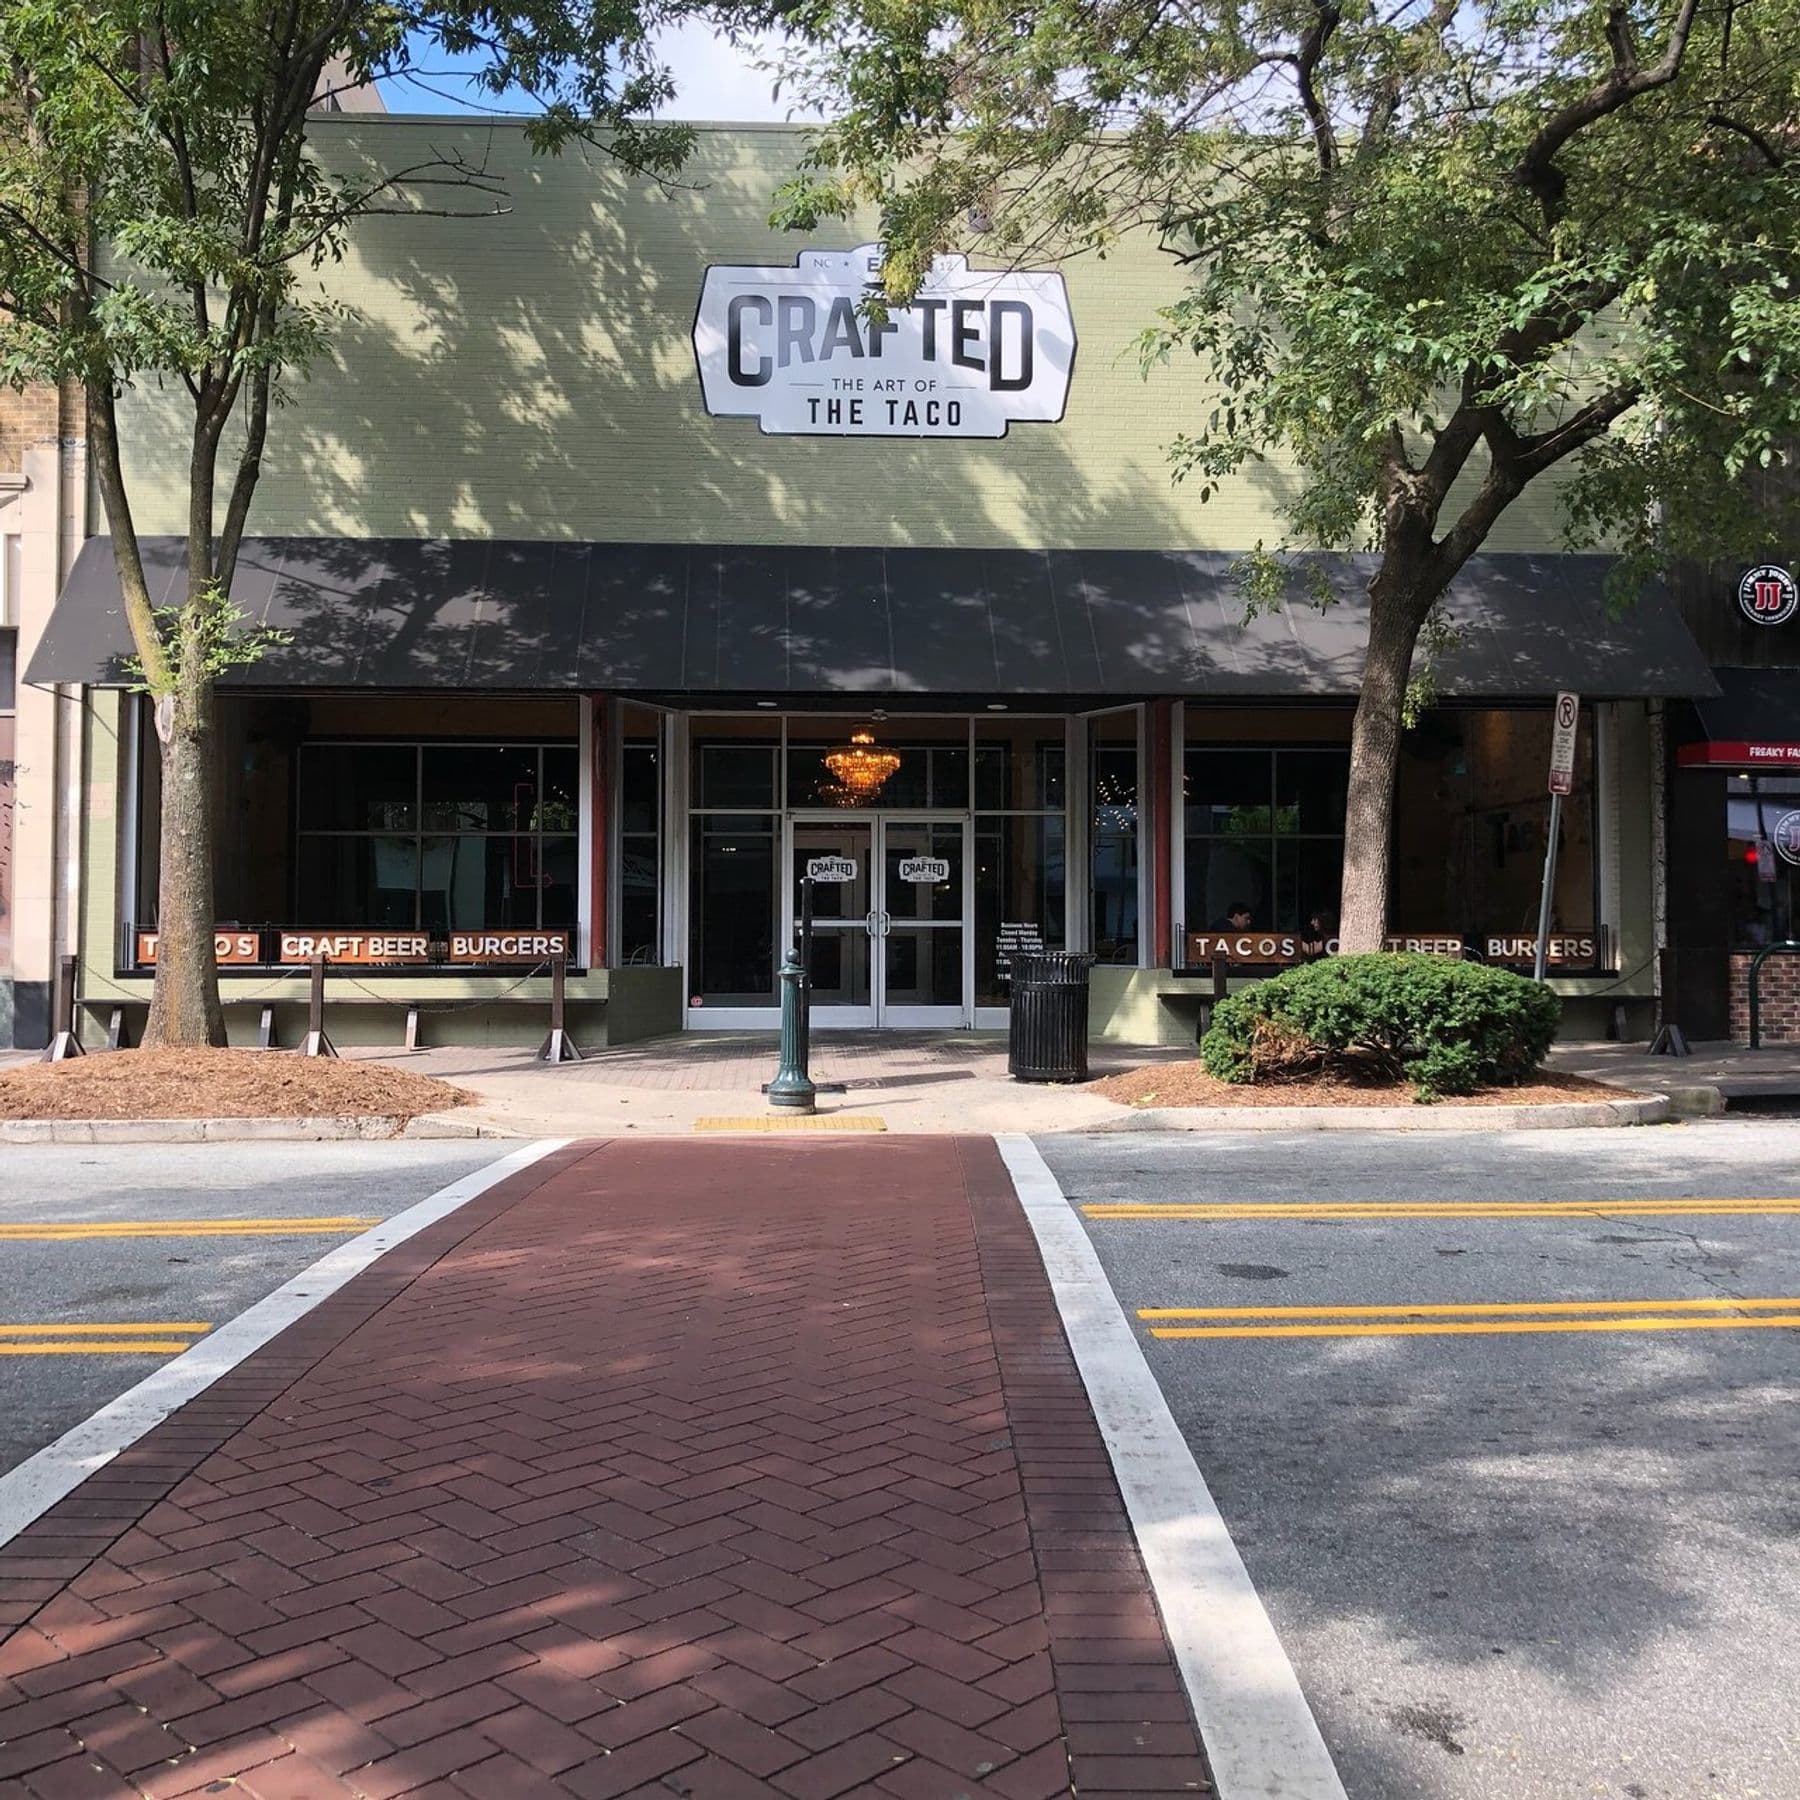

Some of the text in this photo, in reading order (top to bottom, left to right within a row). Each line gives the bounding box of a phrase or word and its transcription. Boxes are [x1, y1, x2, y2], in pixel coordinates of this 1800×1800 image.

[728, 294, 1034, 392] CRAFTED
[832, 378, 937, 393] THE ART OF
[807, 398, 961, 426] THE TACO
[1755, 582, 1782, 610] JJ
[1749, 746, 1786, 757] FREAKY
[811, 862, 853, 876] CRAFTED
[902, 863, 945, 876] CRAFTED
[143, 936, 254, 957] TOS
[281, 936, 428, 957] CRAFT BEER
[452, 936, 564, 956] BURGERS
[1195, 938, 1295, 957] TACOS
